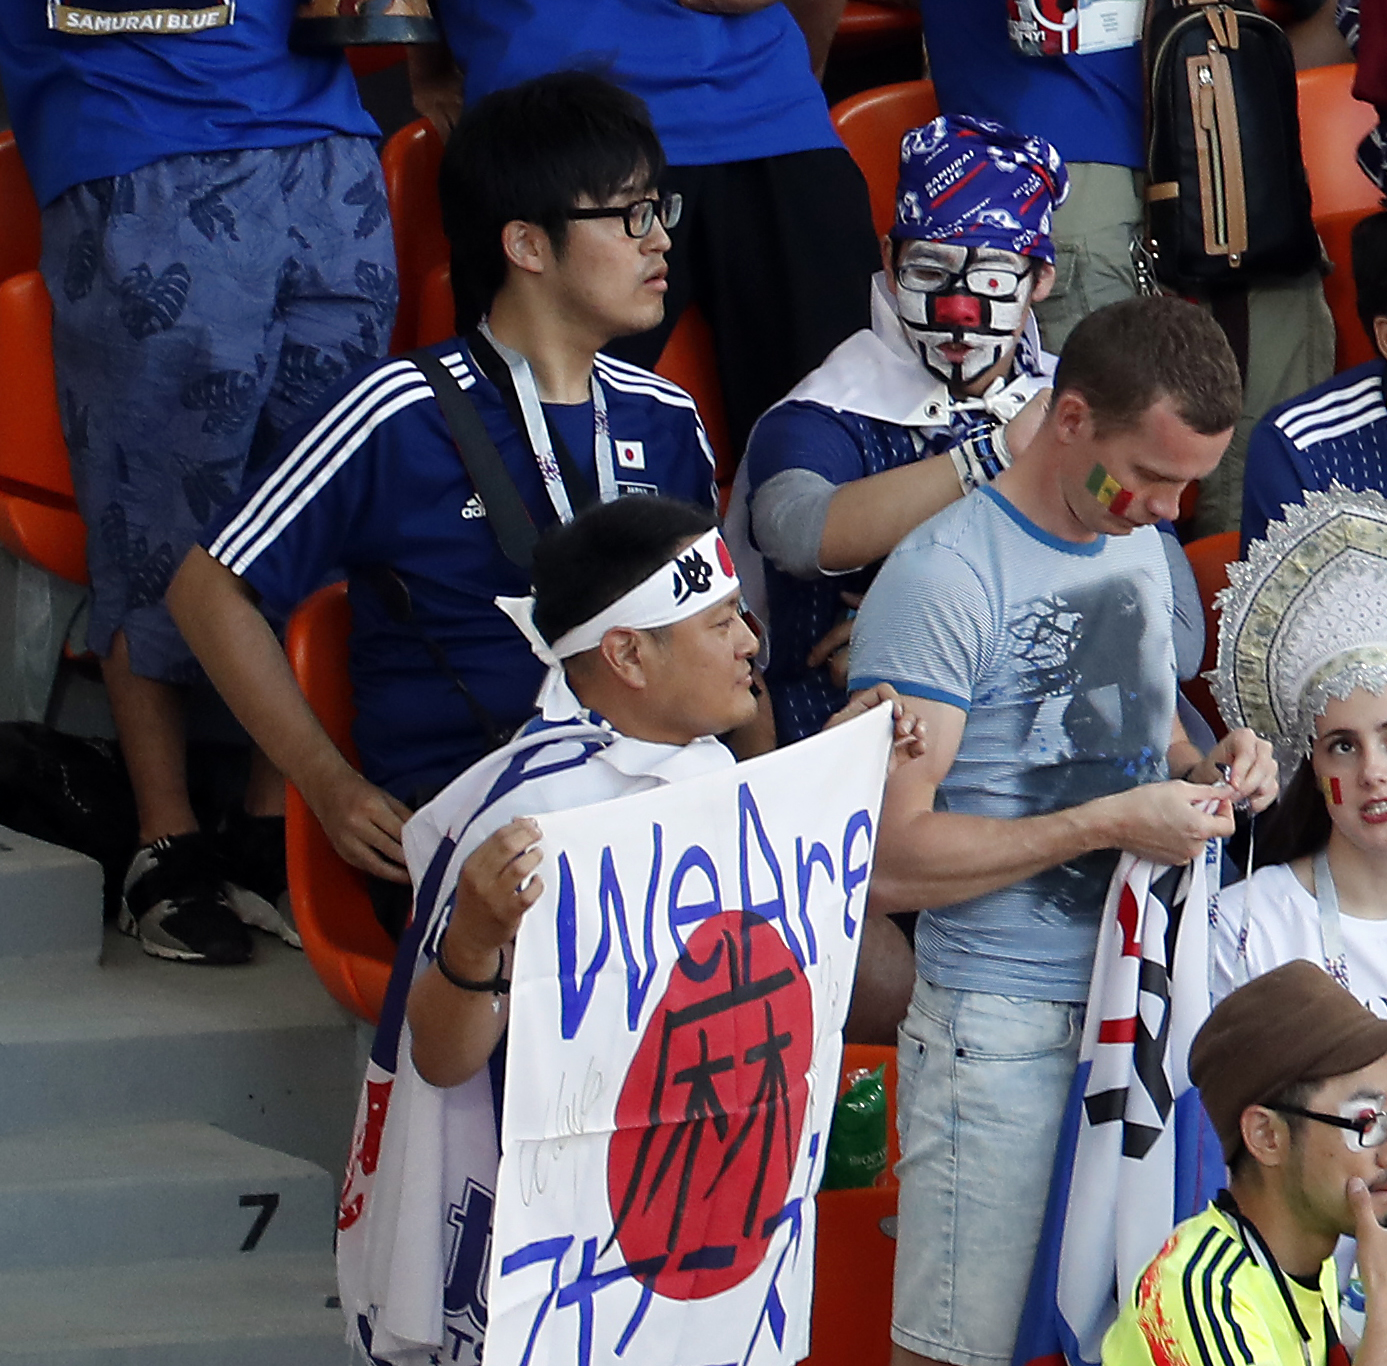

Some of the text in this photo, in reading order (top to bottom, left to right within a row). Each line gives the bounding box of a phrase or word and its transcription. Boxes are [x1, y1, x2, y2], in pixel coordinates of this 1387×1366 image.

[67, 12, 220, 31] SAMURAI BLUE
[924, 149, 975, 191] SAMURAI
[928, 169, 965, 198] BLUE
[671, 546, 713, 607] 必
[239, 1193, 280, 1252] 7
